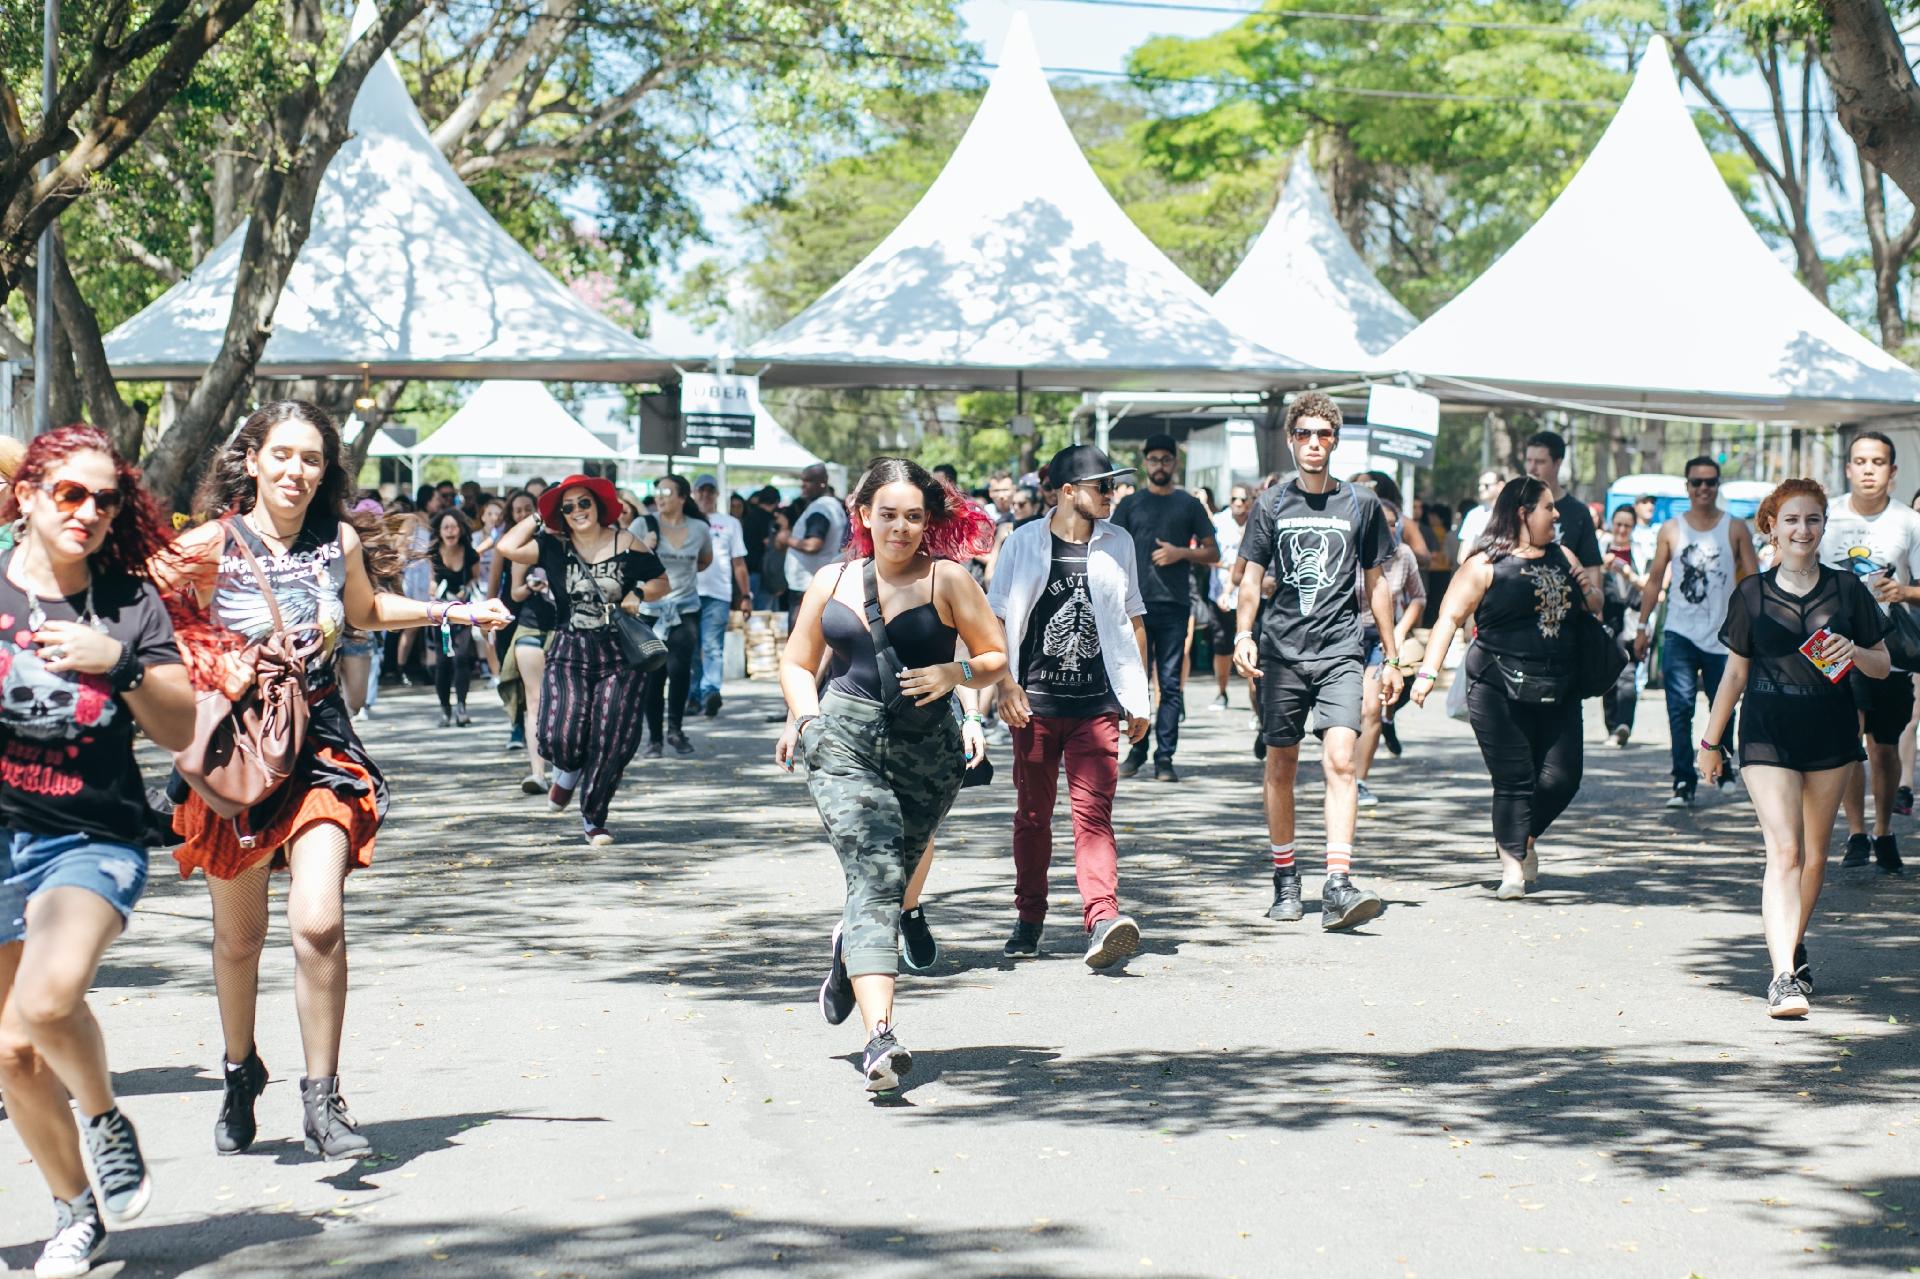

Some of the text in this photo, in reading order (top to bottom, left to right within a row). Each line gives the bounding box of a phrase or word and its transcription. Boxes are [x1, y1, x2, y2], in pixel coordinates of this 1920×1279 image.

[1047, 576, 1084, 596] LIFE IS A
